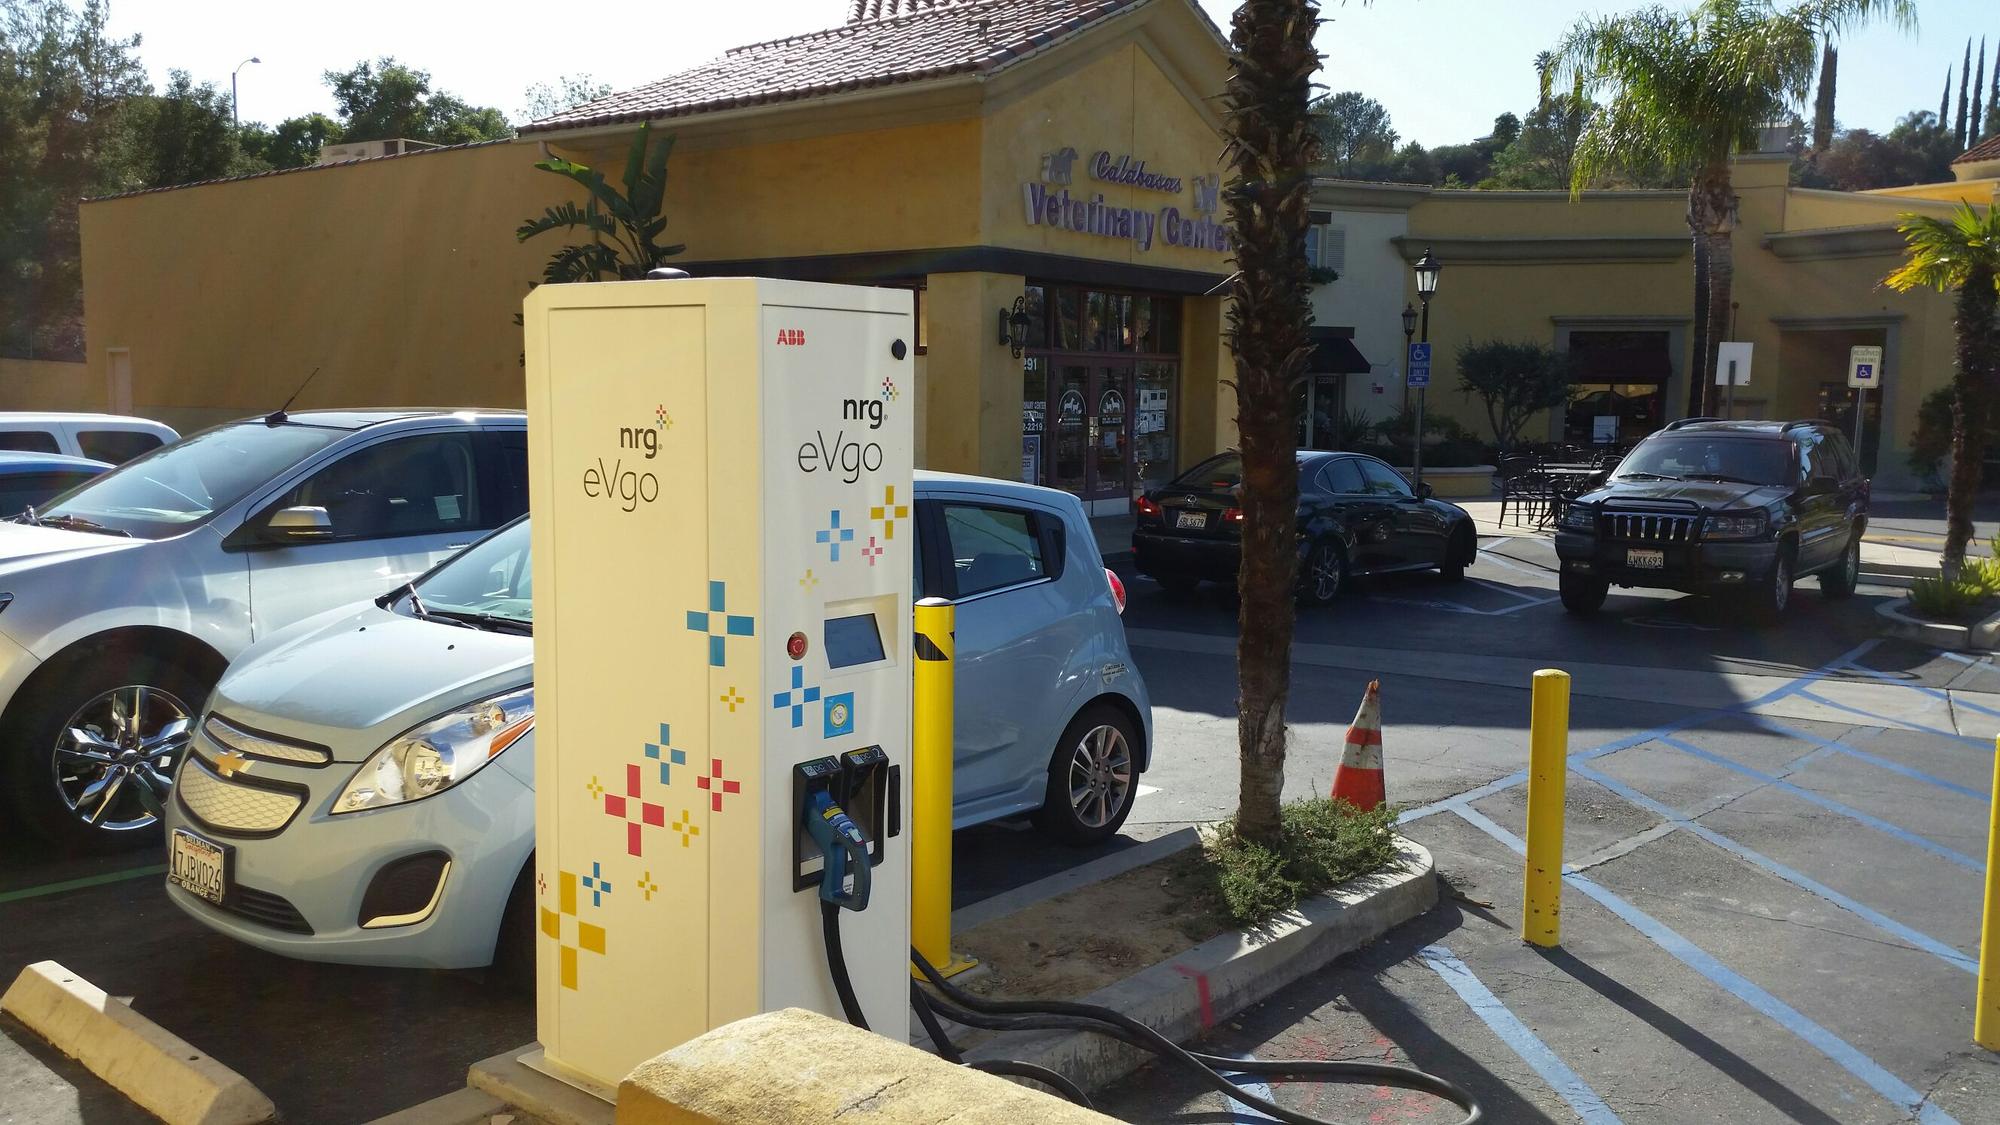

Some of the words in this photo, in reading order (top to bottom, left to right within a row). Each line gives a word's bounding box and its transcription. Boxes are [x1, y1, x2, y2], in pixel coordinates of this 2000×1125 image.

[1092, 150, 1183, 193] Calabasas
[1024, 182, 1155, 250] Veterinary
[777, 328, 806, 346] ABB
[843, 398, 883, 430] nrg
[620, 427, 657, 460] nrg
[797, 430, 883, 484] eVgo
[583, 457, 659, 513] eVgo
[872, 747, 884, 758] 2
[181, 880, 209, 898] ORANGE
